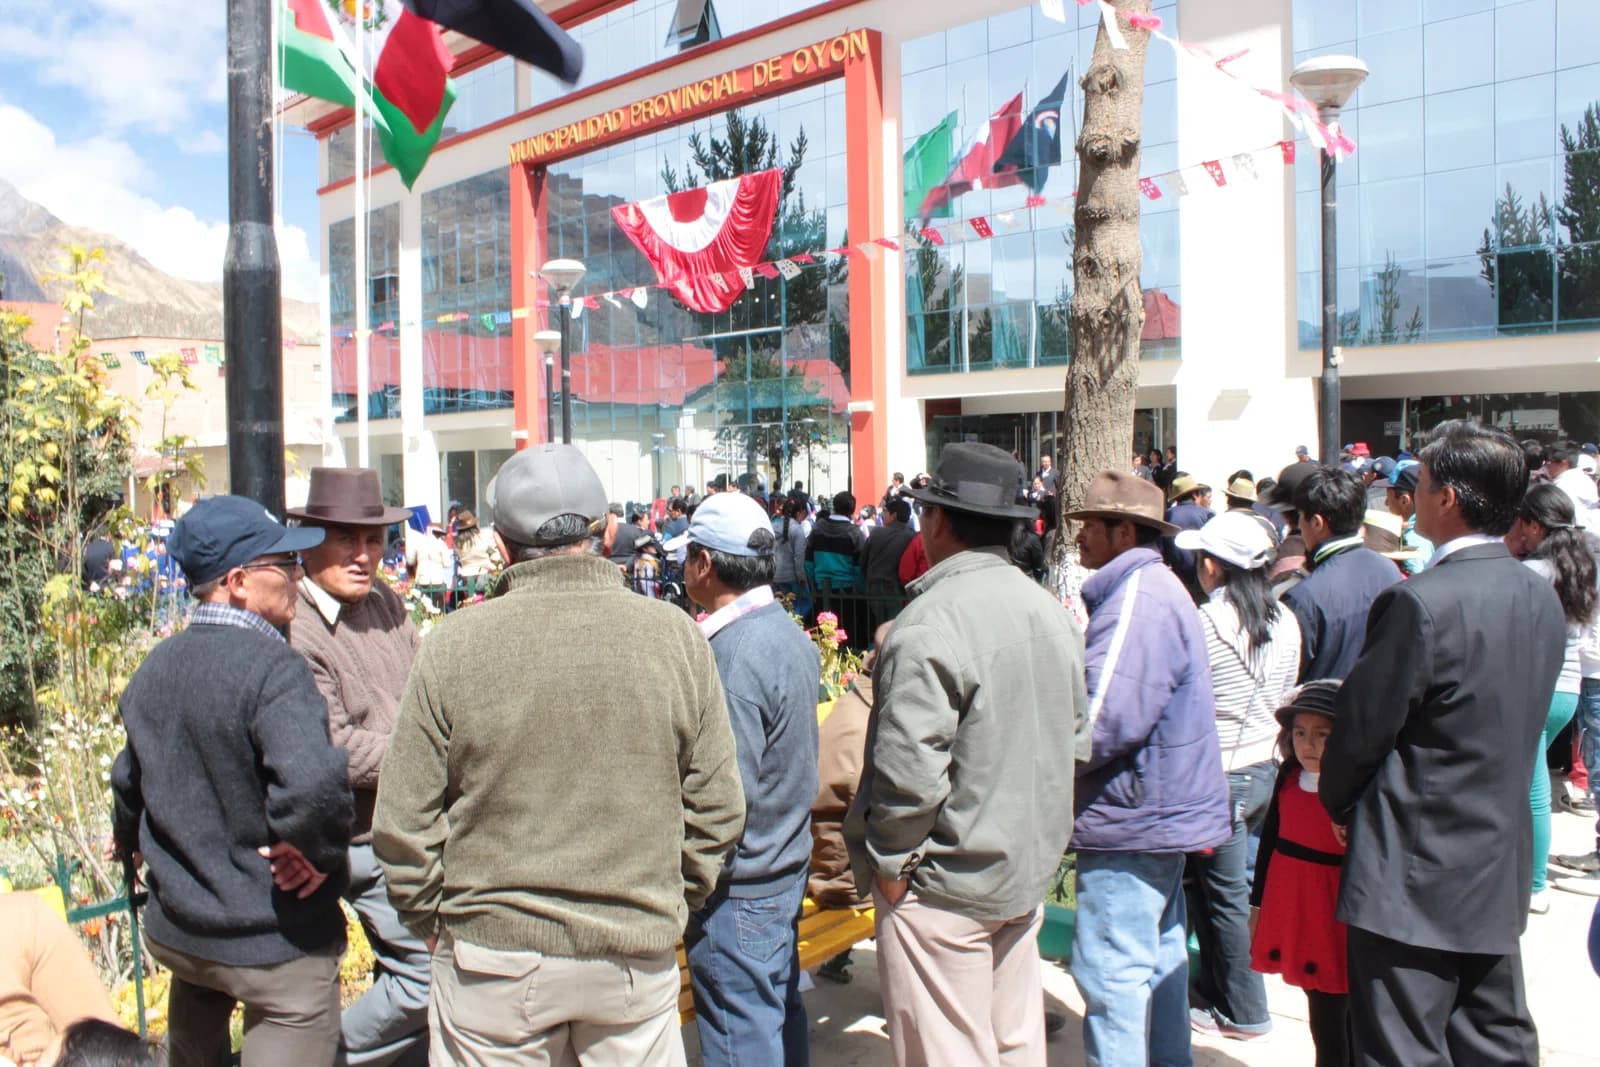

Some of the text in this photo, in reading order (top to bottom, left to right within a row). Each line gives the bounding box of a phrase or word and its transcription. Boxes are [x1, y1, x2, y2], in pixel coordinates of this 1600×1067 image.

[509, 109, 625, 164] MUNICIPALIDAD
[630, 70, 744, 126] PROVINCIAL
[753, 55, 783, 87] DE
